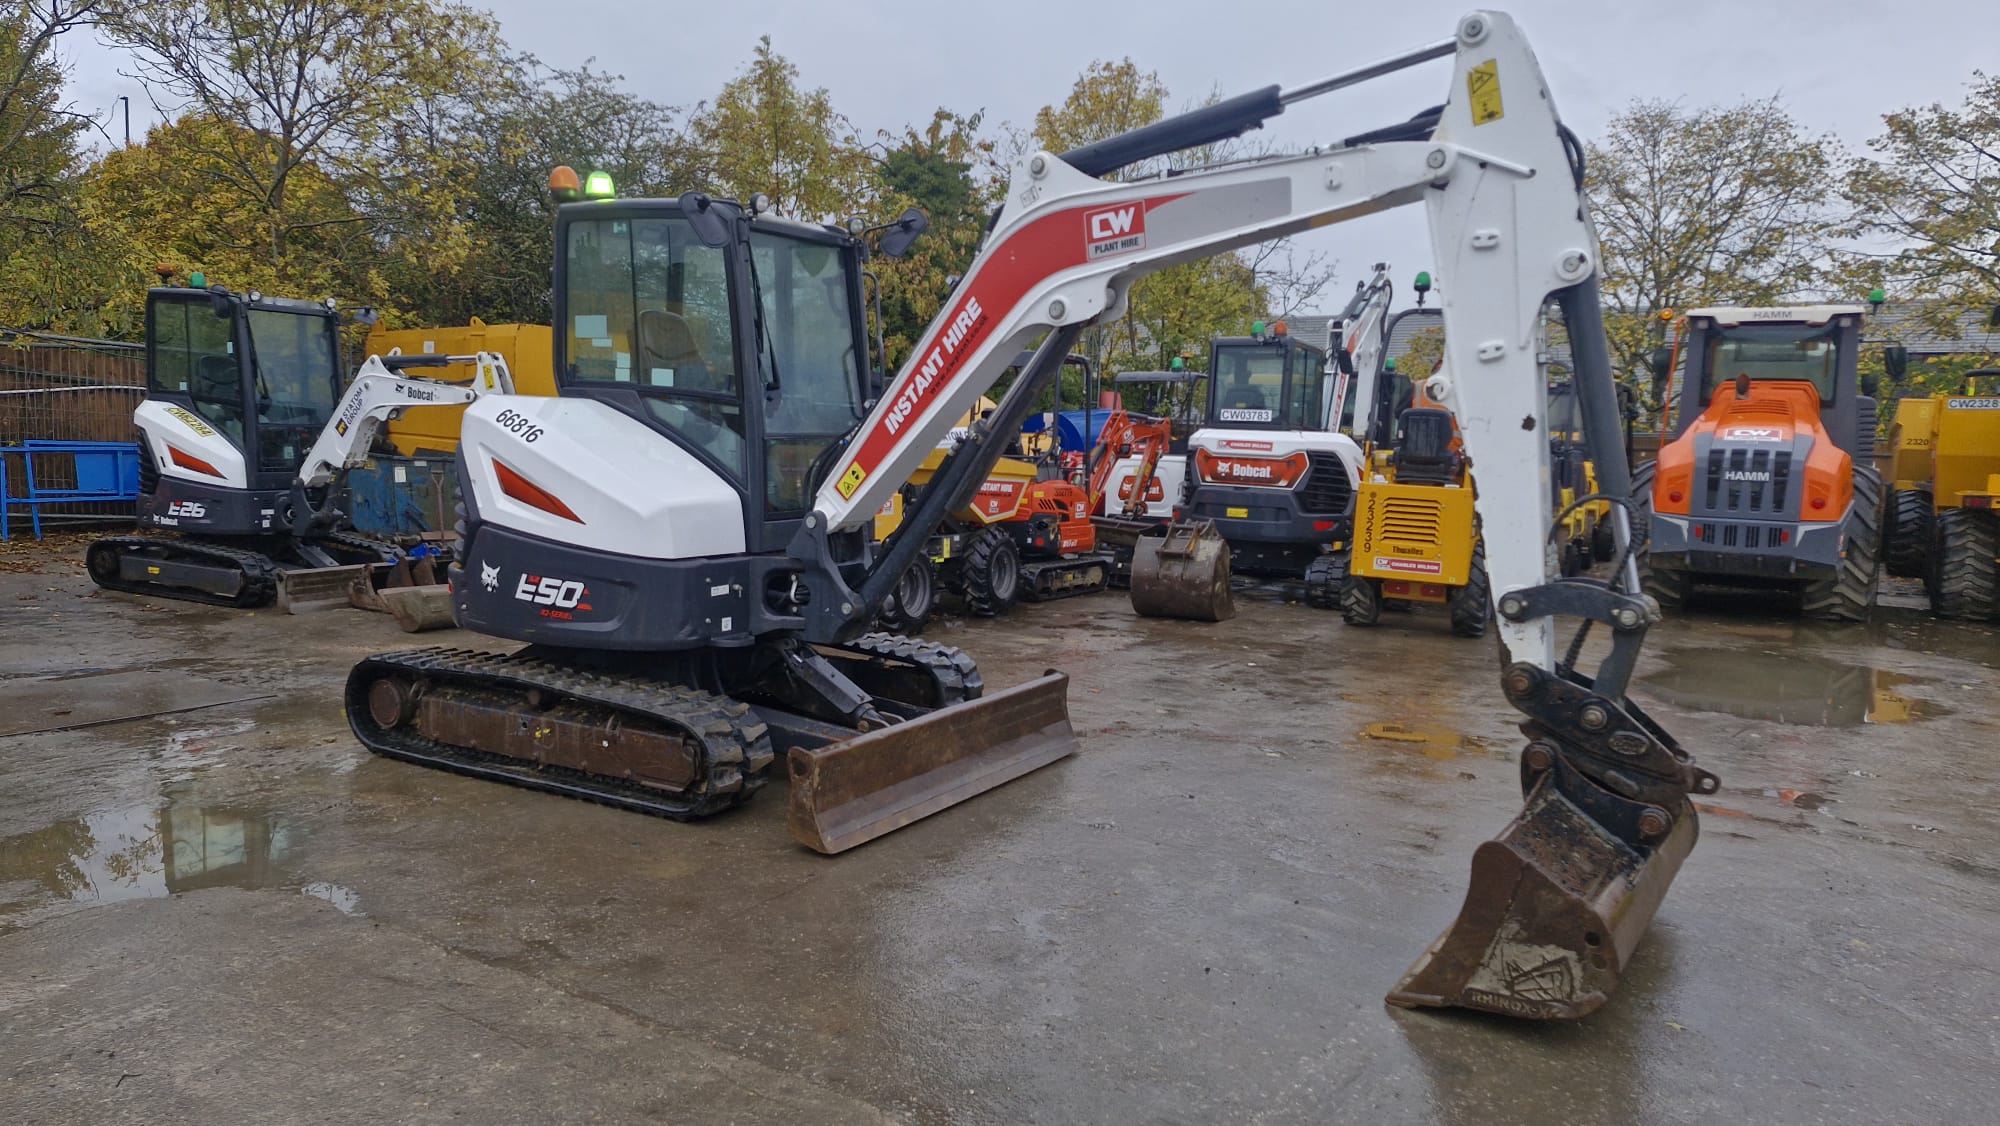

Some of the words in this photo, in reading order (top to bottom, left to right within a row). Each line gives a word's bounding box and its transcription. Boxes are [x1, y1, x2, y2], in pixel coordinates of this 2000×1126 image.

[1091, 206, 1135, 239] CW
[1094, 241, 1118, 254] PLANT
[1121, 237, 1139, 249] HIRE
[1752, 310, 1793, 319] HAMM
[884, 347, 944, 436] INSTANT
[942, 296, 983, 354] HIRE
[342, 386, 363, 418] STATOM
[407, 386, 434, 402] Bobcat
[347, 398, 363, 425] GROUP
[1221, 410, 1270, 421] CW03783
[495, 408, 544, 443] 66816
[1233, 463, 1271, 478] Bobcat
[1725, 470, 1770, 482] HAMM
[168, 501, 206, 518] E26
[1363, 499, 1376, 553] 23239
[515, 573, 585, 608] E50
